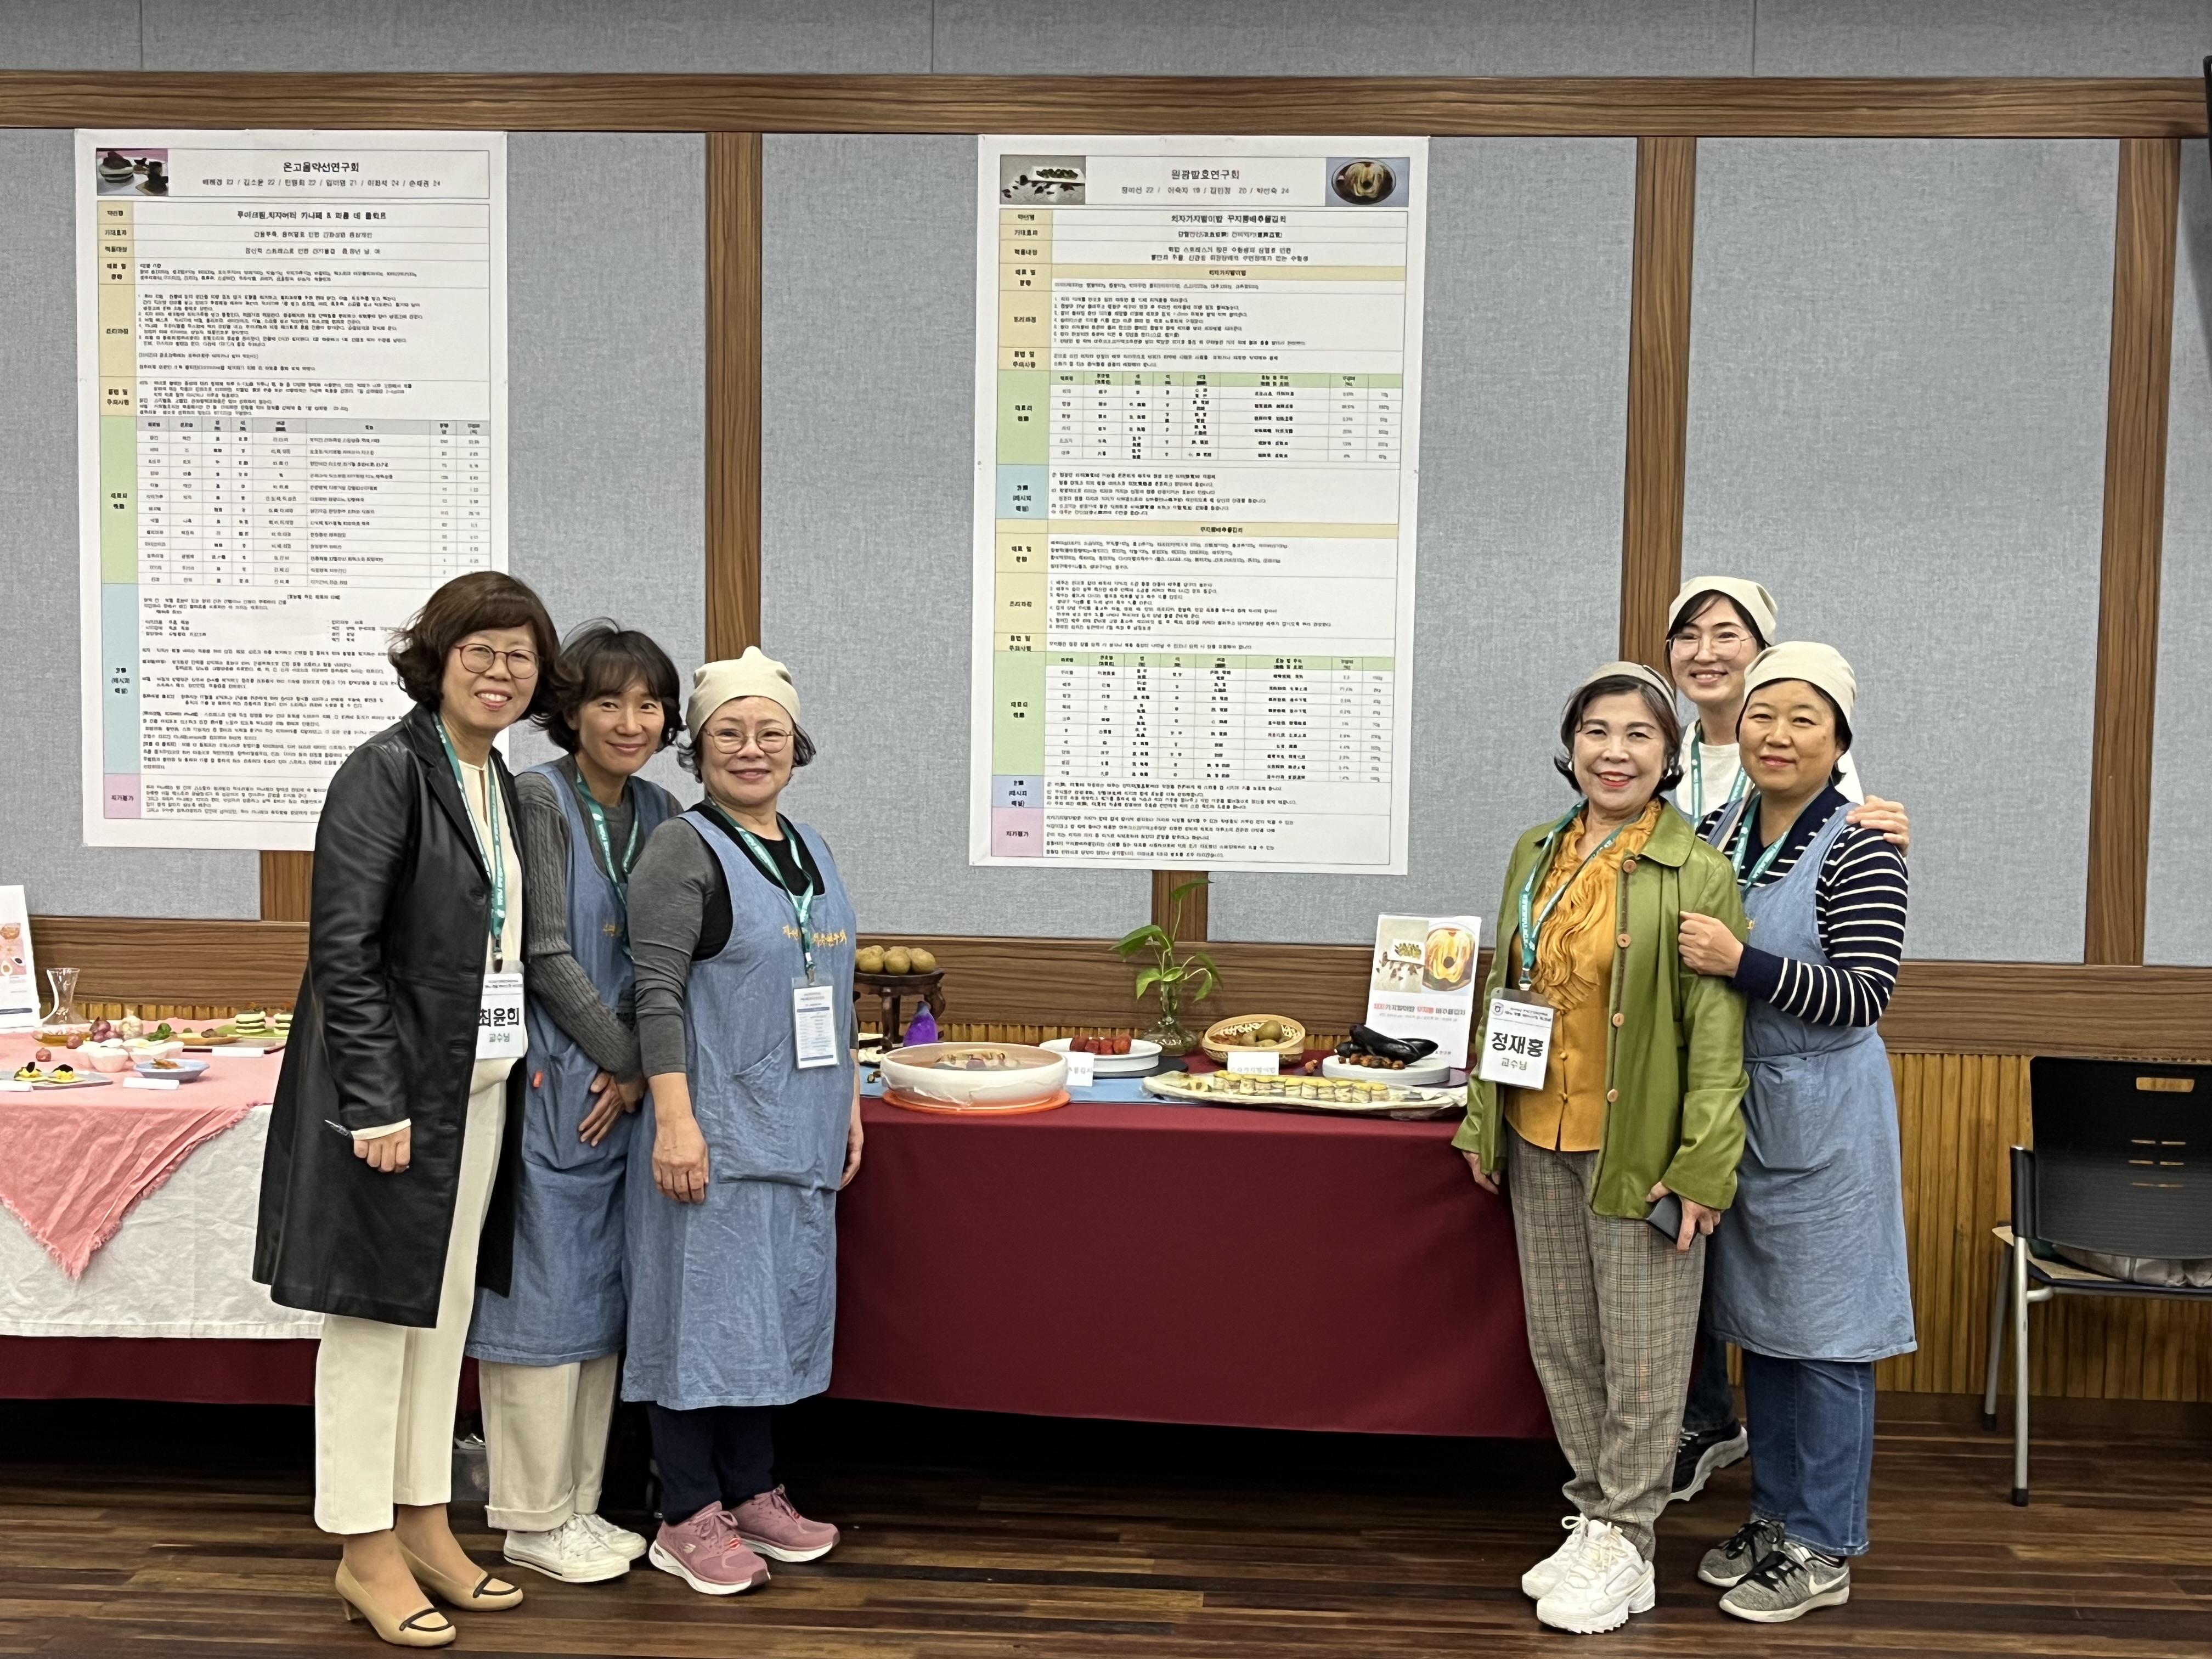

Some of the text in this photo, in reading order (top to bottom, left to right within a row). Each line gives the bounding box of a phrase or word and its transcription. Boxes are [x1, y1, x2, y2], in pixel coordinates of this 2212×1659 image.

[283, 161, 359, 173] 온고을약선연구회
[1171, 169, 1240, 180] 원광발효연구회
[478, 1007, 520, 1027] 최윤희
[489, 1032, 510, 1043] 교수님
[1492, 1031, 1544, 1058] 정재홍
[1501, 1057, 1527, 1071] 교수님
